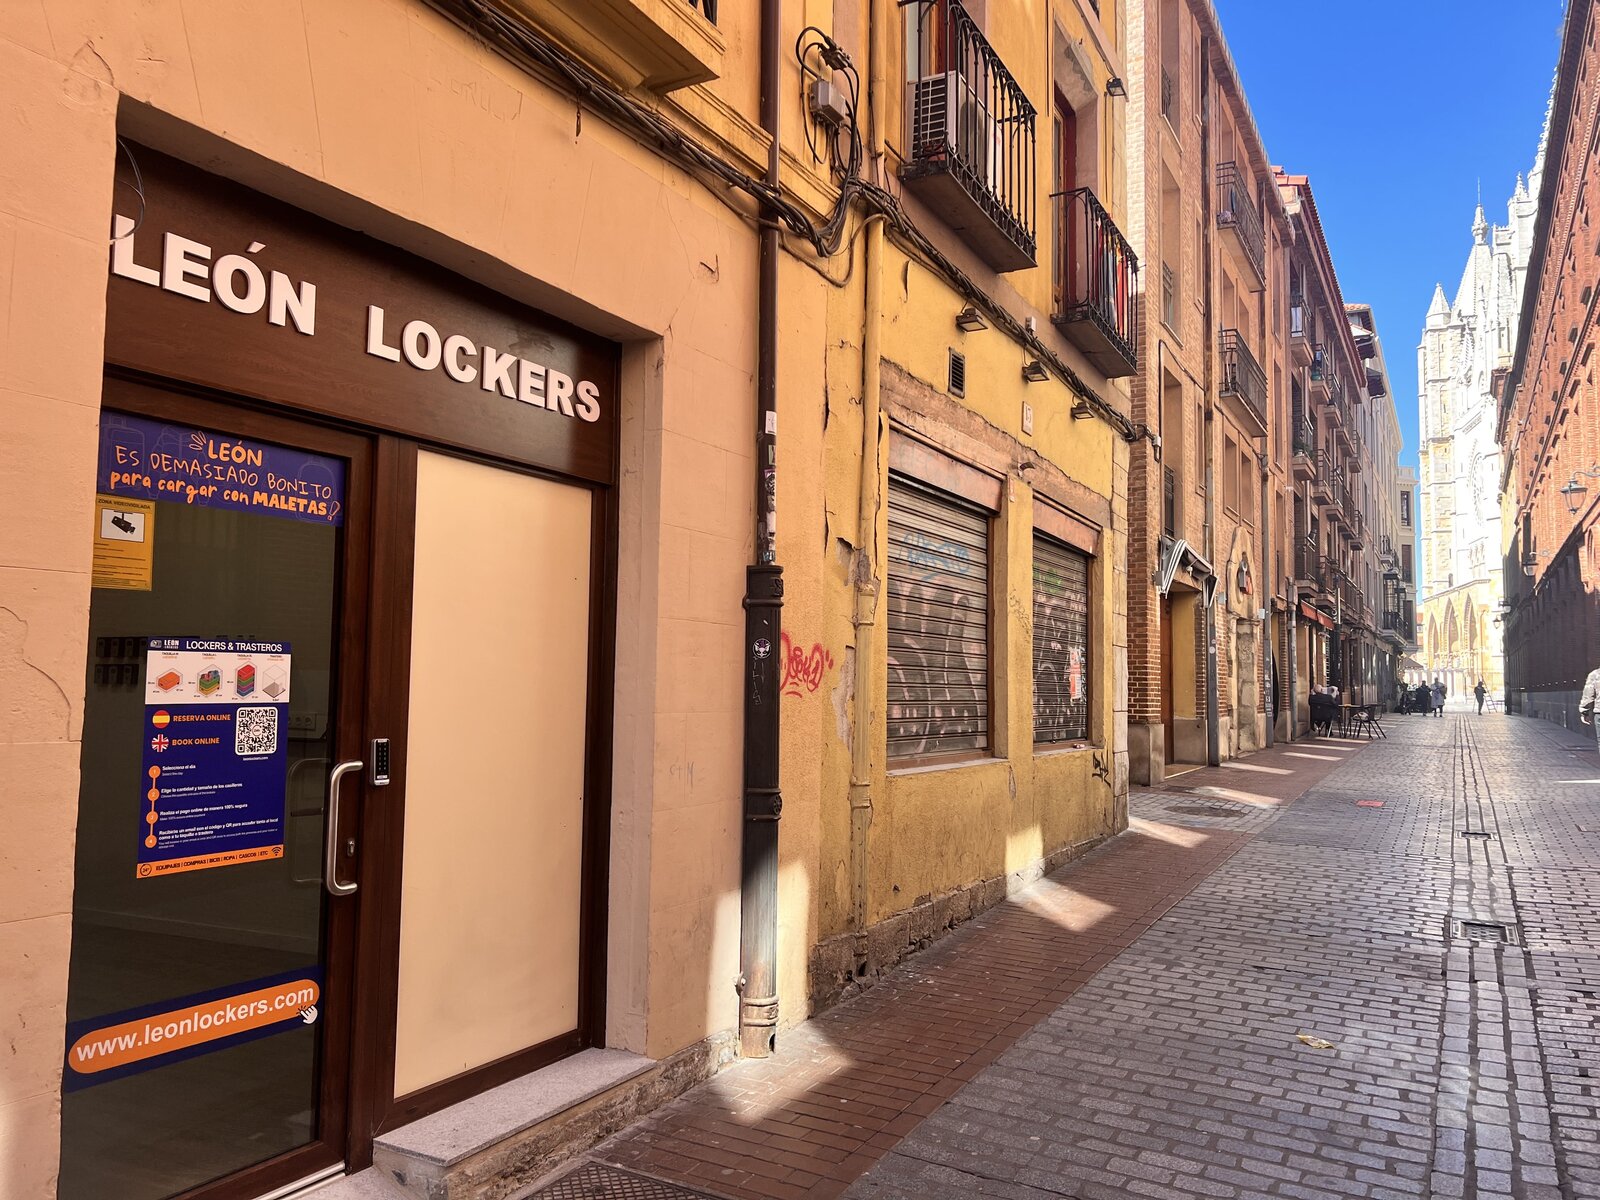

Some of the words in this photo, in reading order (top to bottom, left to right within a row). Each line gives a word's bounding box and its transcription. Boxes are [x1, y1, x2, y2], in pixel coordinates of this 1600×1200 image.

[111, 213, 317, 336] LEÓN
[366, 305, 600, 422] LOCKERS
[115, 446, 140, 466] ES
[150, 453, 259, 486] DEMASIADO
[267, 473, 332, 499] BONITO
[208, 440, 263, 466] LEÓN
[110, 471, 151, 490] para
[158, 478, 217, 504] cargar
[224, 490, 248, 505] con
[186, 641, 226, 650] LOCKERS
[228, 642, 234, 650] &
[236, 643, 282, 652] TRASTEROS
[77, 987, 314, 1062] www.leonlockers.com
